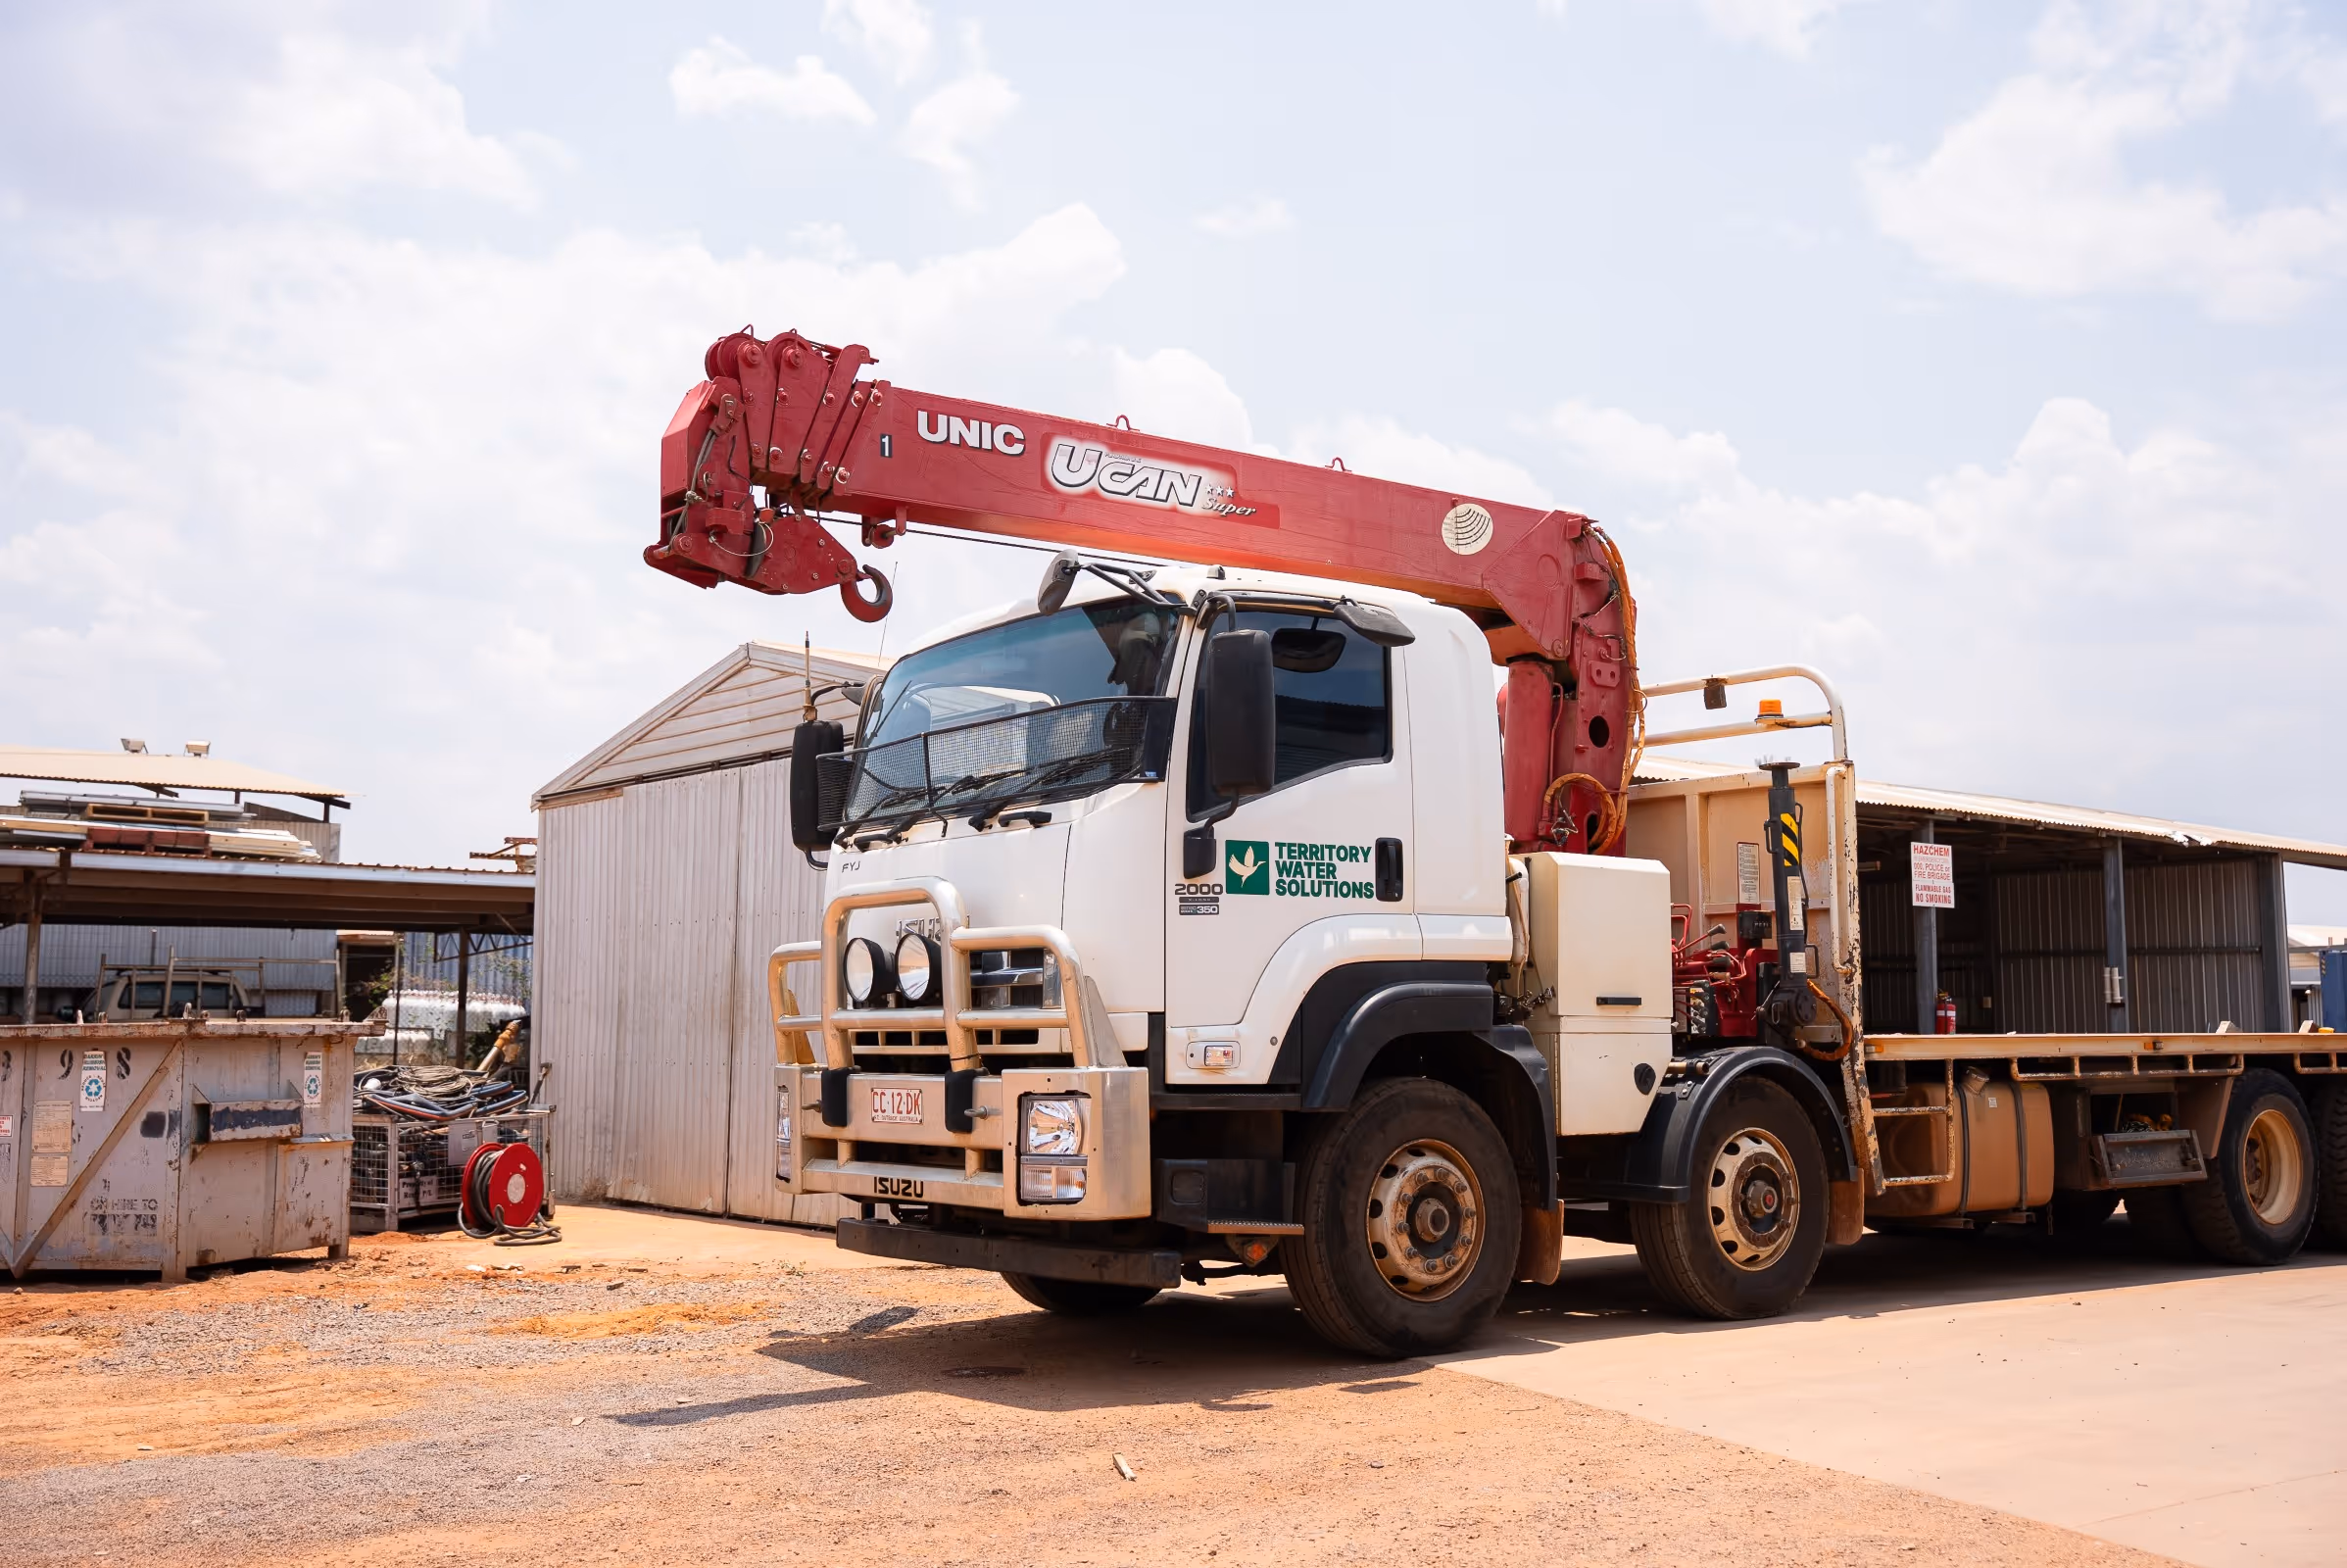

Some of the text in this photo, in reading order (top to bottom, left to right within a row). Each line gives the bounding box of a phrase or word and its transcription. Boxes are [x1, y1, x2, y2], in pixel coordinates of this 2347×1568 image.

[917, 410, 1026, 456] UNIC
[881, 435, 890, 457] 1
[1051, 444, 1202, 507] UCAN
[1202, 497, 1257, 517] Super
[1275, 842, 1373, 862] TERRITORY
[1913, 845, 1950, 858] HAZCHEM
[842, 860, 861, 873] FYJ
[1275, 860, 1338, 880] WATER
[1925, 863, 1944, 872] POLICE
[1927, 872, 1951, 881] BRIGADE
[1174, 883, 1224, 896] 2000
[1275, 879, 1375, 900] SOLUTIONS
[1915, 884, 1941, 893] FLAMMABLE
[1915, 893, 1952, 905] NO SMOKING
[1197, 906, 1218, 914] 350
[873, 1176, 924, 1198] ISUZU
